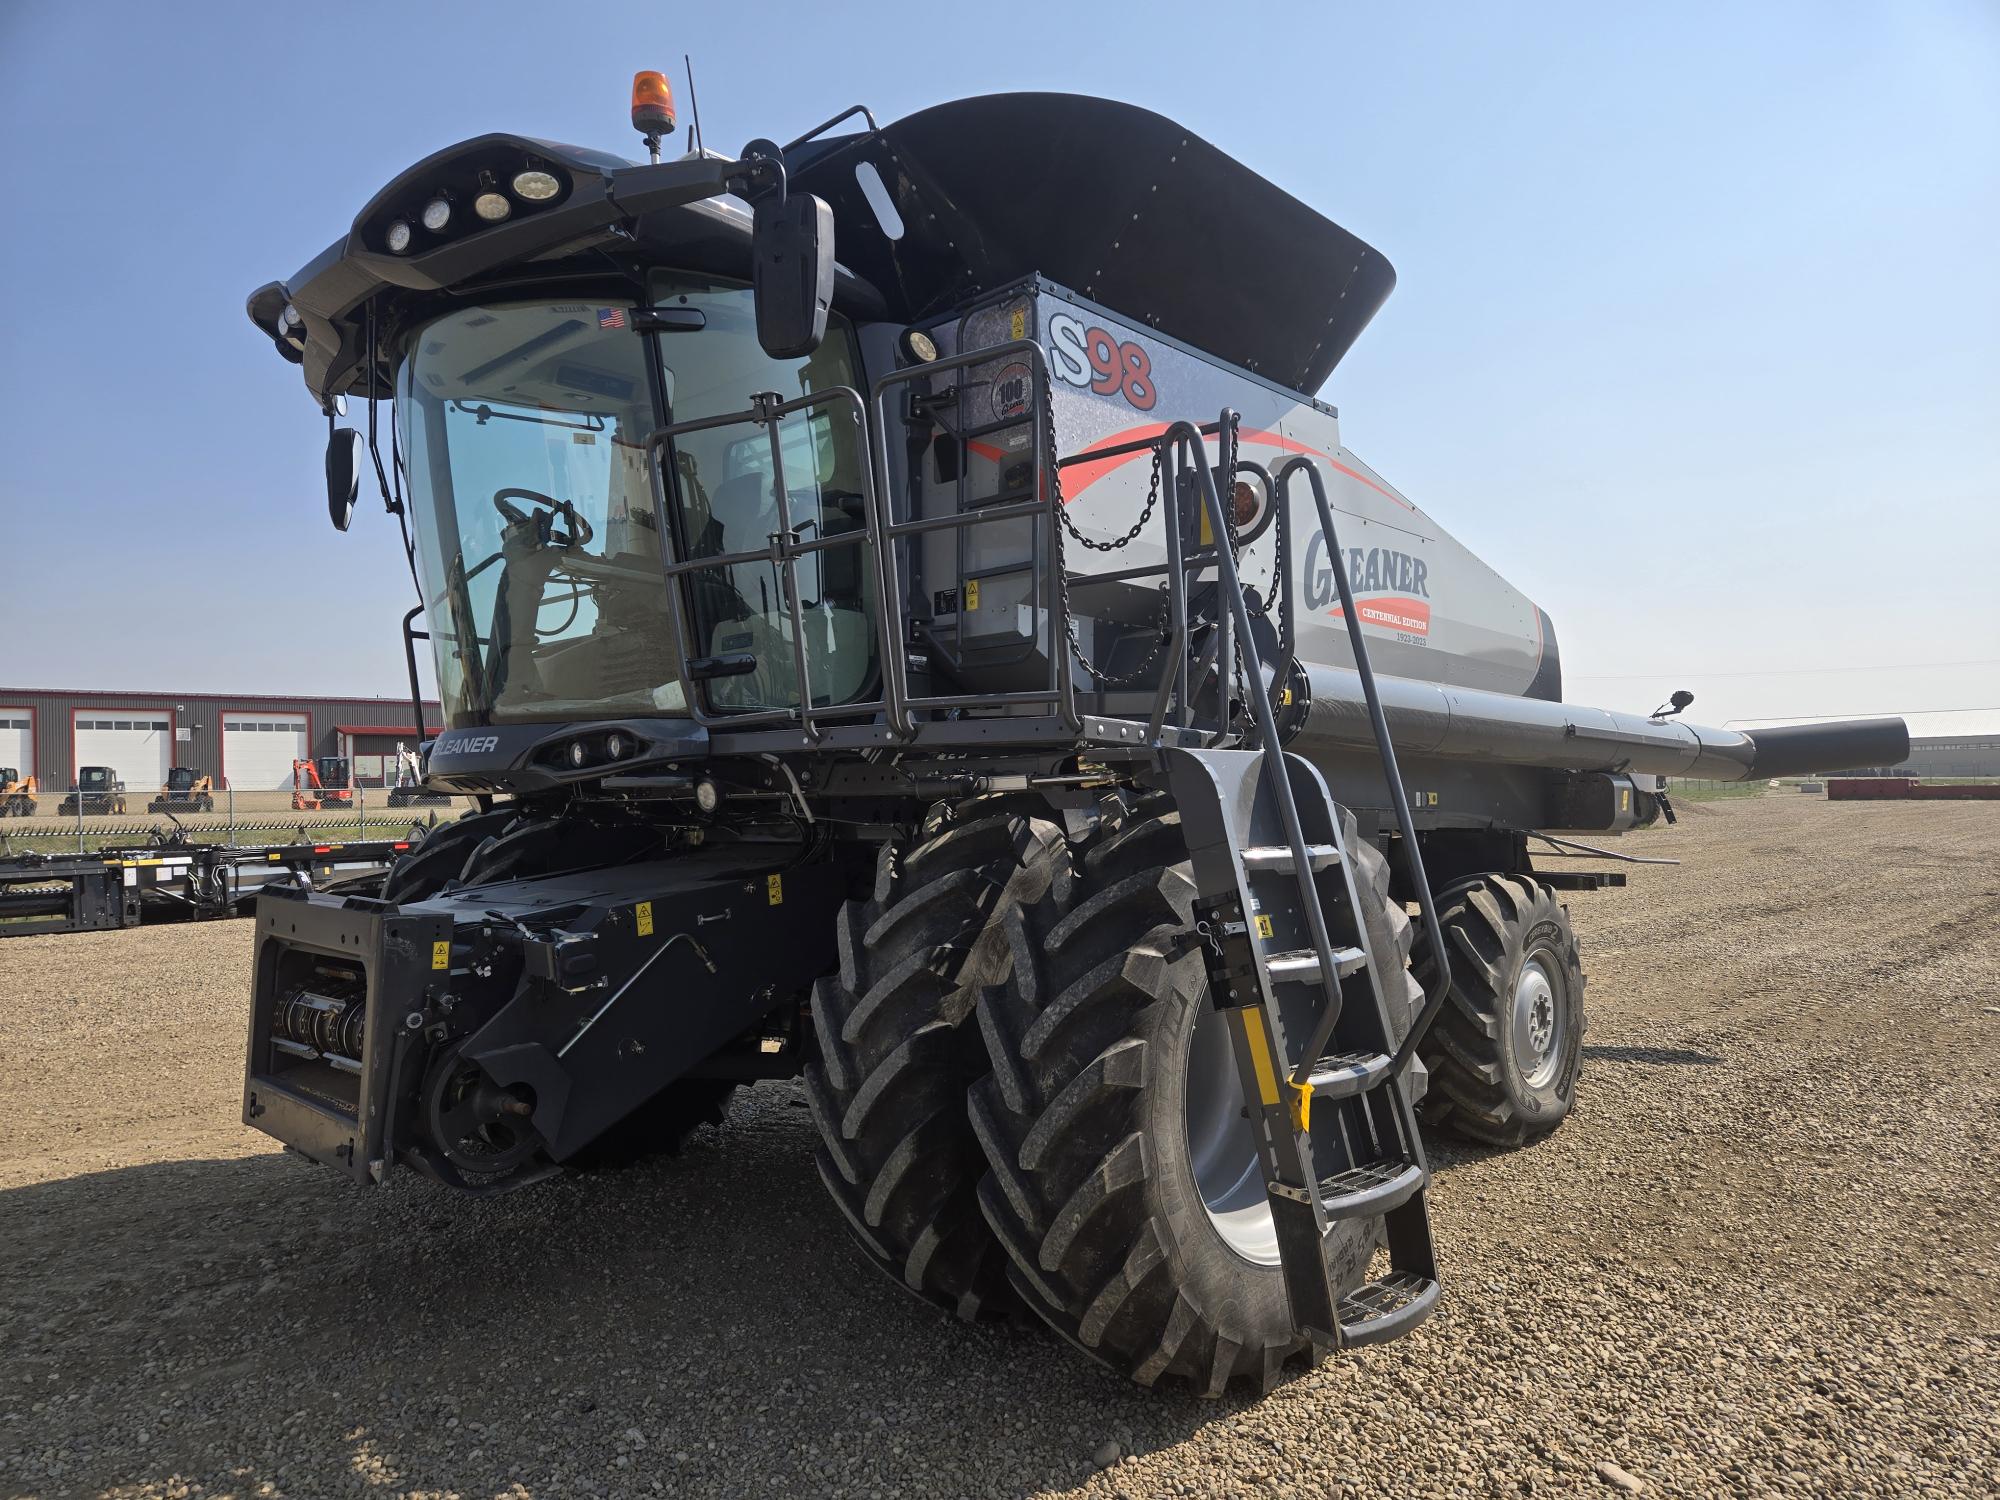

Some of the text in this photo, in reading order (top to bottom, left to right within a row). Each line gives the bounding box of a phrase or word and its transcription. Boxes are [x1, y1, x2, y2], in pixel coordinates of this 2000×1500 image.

[1049, 312, 1157, 412] S98
[999, 378, 1023, 405] 100
[1362, 607, 1427, 631] CENTENNIAL EDITION
[1396, 632, 1427, 647] 1923-2023
